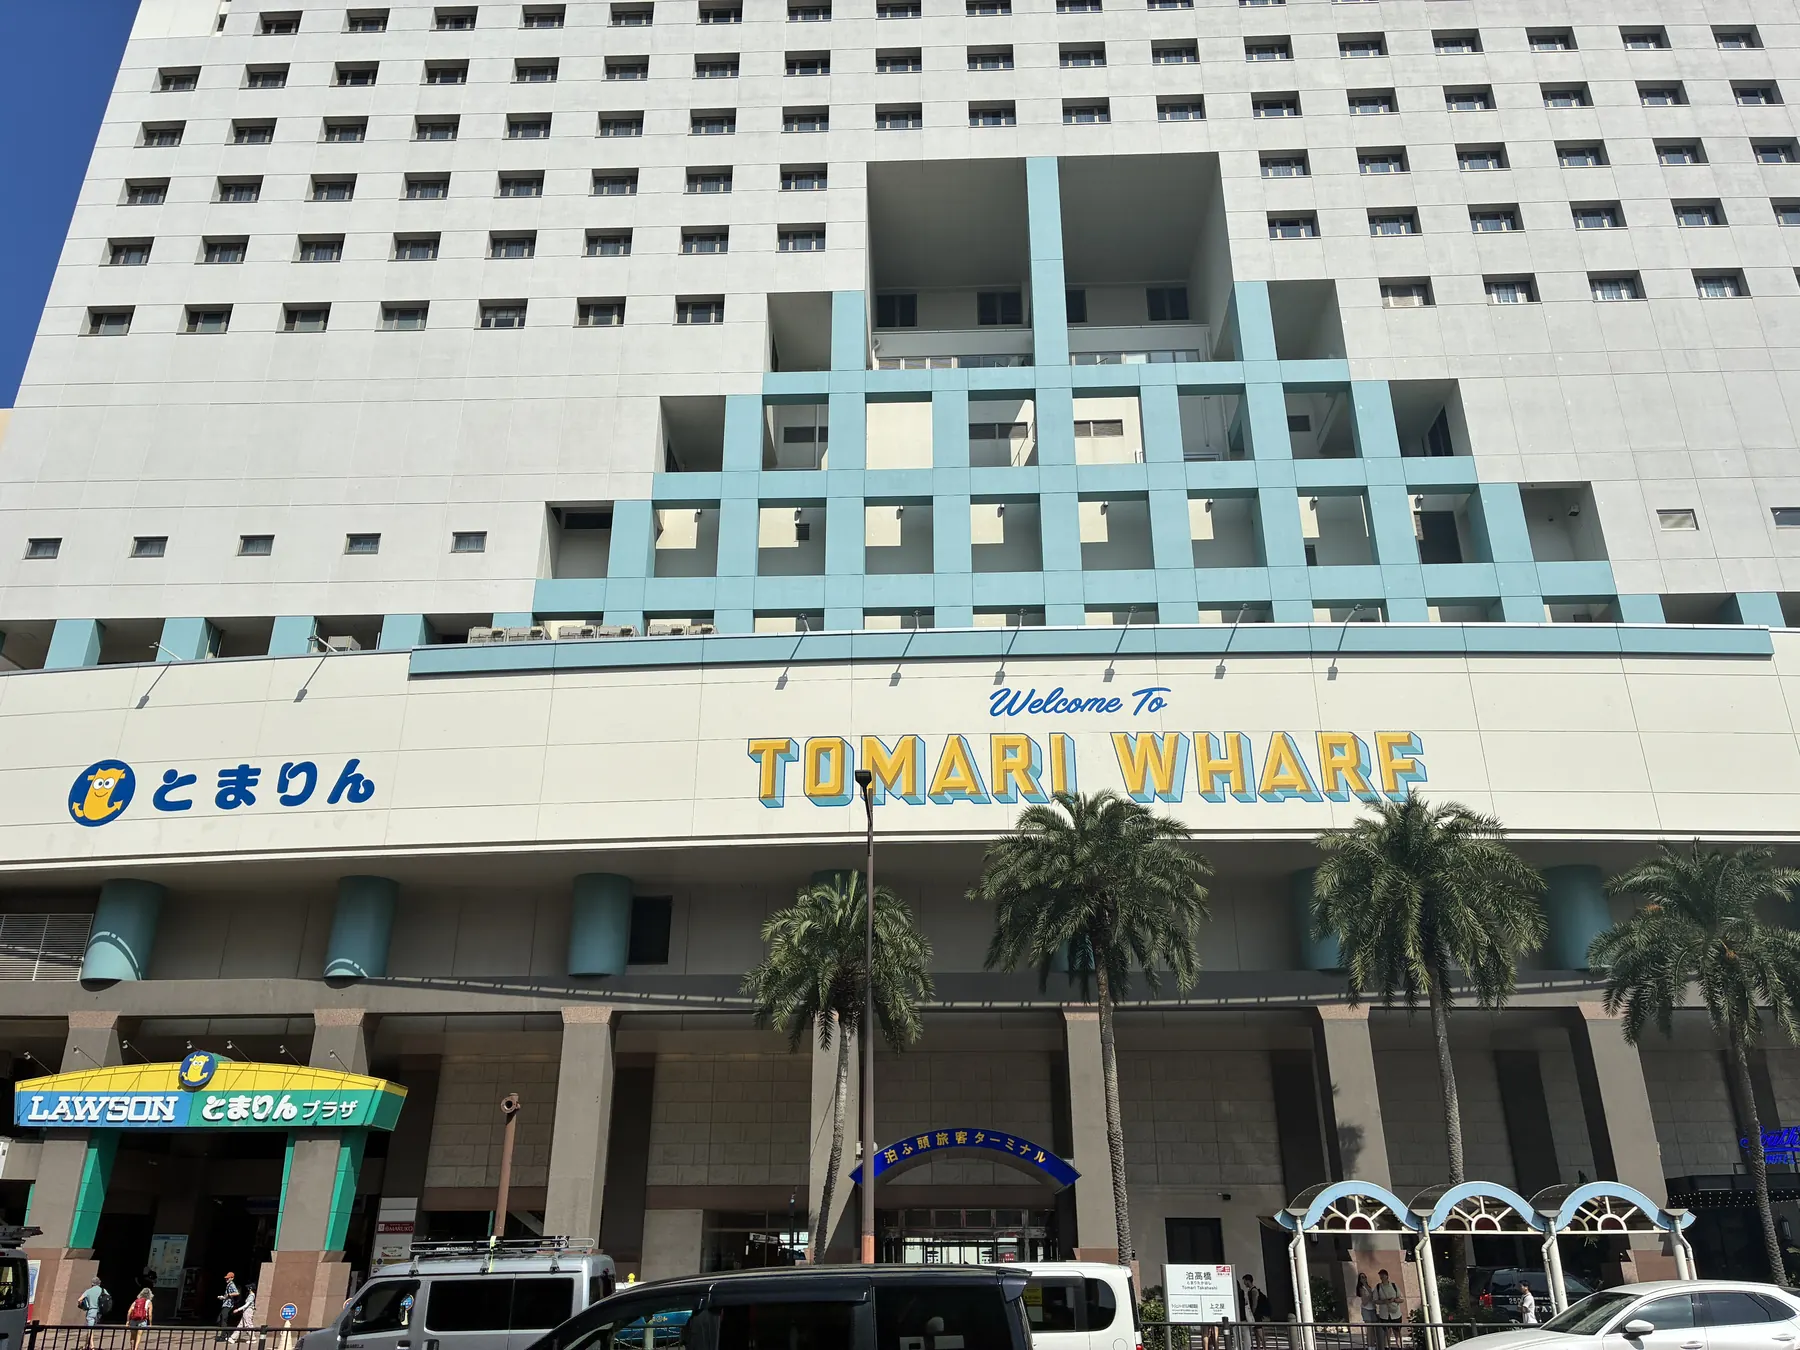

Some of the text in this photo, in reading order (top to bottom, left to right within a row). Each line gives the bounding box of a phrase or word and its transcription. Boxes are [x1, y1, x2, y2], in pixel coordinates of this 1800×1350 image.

[989, 686, 1172, 717] Welcome To
[152, 758, 376, 812] とまりん
[747, 731, 1428, 808] TOMARI WHARF
[27, 1095, 179, 1122] LAWSON
[884, 1131, 1047, 1164] 泊ふ頭旅客ターミナル
[1186, 1272, 1212, 1280] 泊高橋
